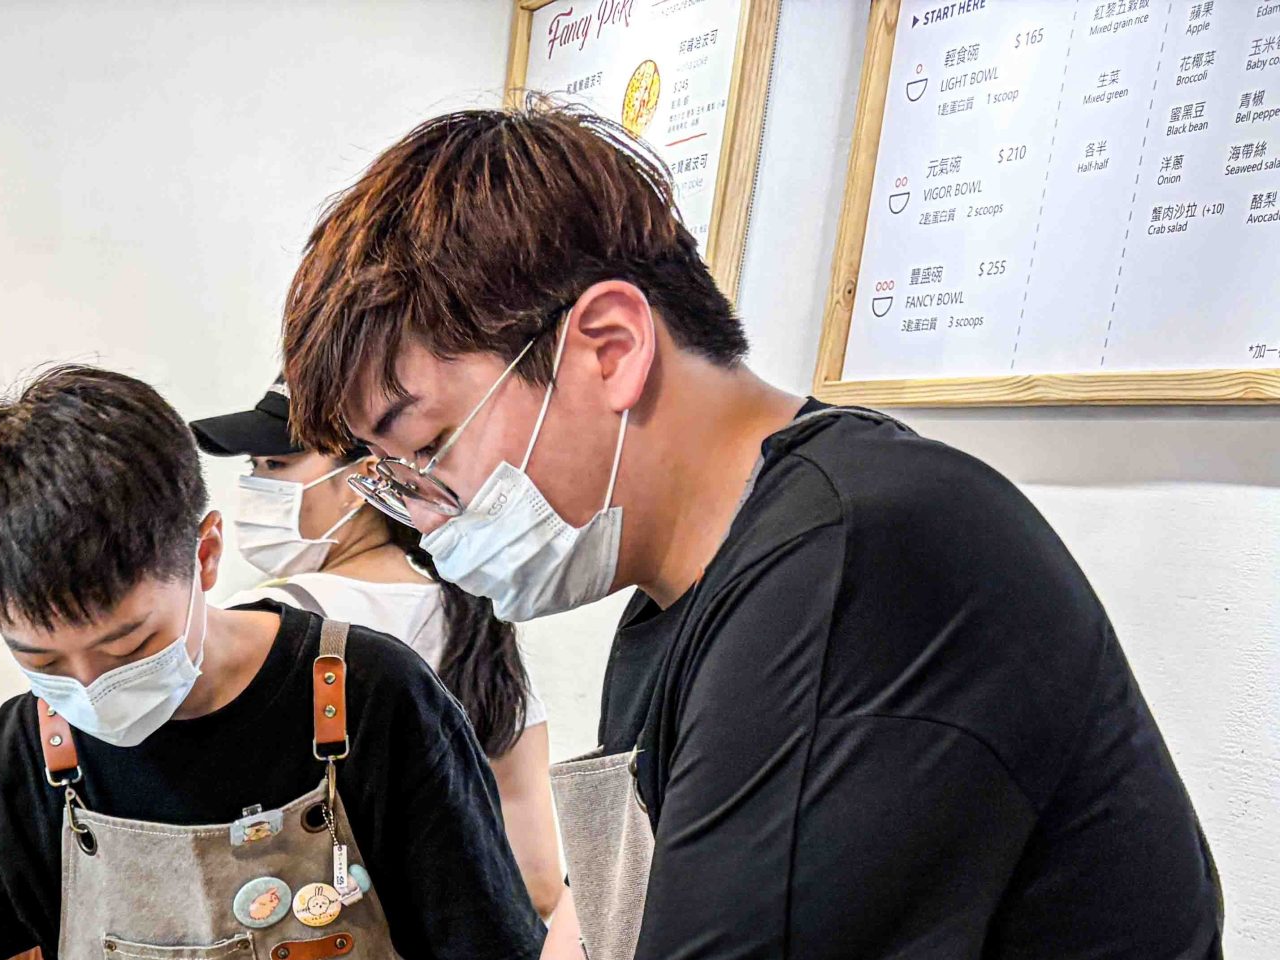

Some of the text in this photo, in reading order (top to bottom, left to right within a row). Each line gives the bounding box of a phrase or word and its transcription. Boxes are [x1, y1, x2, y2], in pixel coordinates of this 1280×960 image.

[923, 0, 986, 26] START HERE
[1189, 1, 1214, 22] 蘋果
[548, 7, 592, 59] Fancy
[1089, 21, 1113, 36] Mixed
[1113, 17, 1134, 34] grain
[1186, 20, 1211, 36] Apple
[1015, 28, 1044, 49] $ 165
[944, 44, 980, 67] 輕食碗
[1179, 50, 1217, 72] 花椰菜
[1246, 57, 1267, 72] Baby
[940, 67, 999, 92] LIGHT BOWL
[1097, 69, 1121, 88] 生菜
[1176, 70, 1208, 86] Broccoli
[986, 94, 992, 105] 1
[993, 89, 1019, 104] scoop
[1083, 87, 1129, 105] Mixed green
[1239, 90, 1266, 109] 青椒
[1170, 101, 1207, 123] 蜜黑豆
[1235, 109, 1251, 124] Bell
[1166, 121, 1209, 137] Black bean
[998, 145, 1027, 164] $ 210
[1085, 140, 1108, 158] 各半
[1228, 141, 1268, 162] 海帶絲
[926, 155, 962, 179] 元氣碗
[1077, 158, 1110, 173] Half-half
[1225, 158, 1264, 176] Seaweed
[1157, 174, 1181, 186] Onion
[923, 180, 983, 201] VIGOR BOWL
[967, 206, 973, 218] 2
[974, 203, 1004, 217] scoops
[1250, 191, 1278, 211] 酪梨
[1150, 202, 1225, 223] 蟹肉沙拉 (+10)
[1147, 220, 1188, 236] Crab salad
[909, 265, 944, 286] 豐盛碗
[978, 260, 1007, 277] $ 255
[905, 291, 964, 309] FANCY BOWL
[947, 316, 954, 328] 3
[955, 315, 984, 329] scoops
